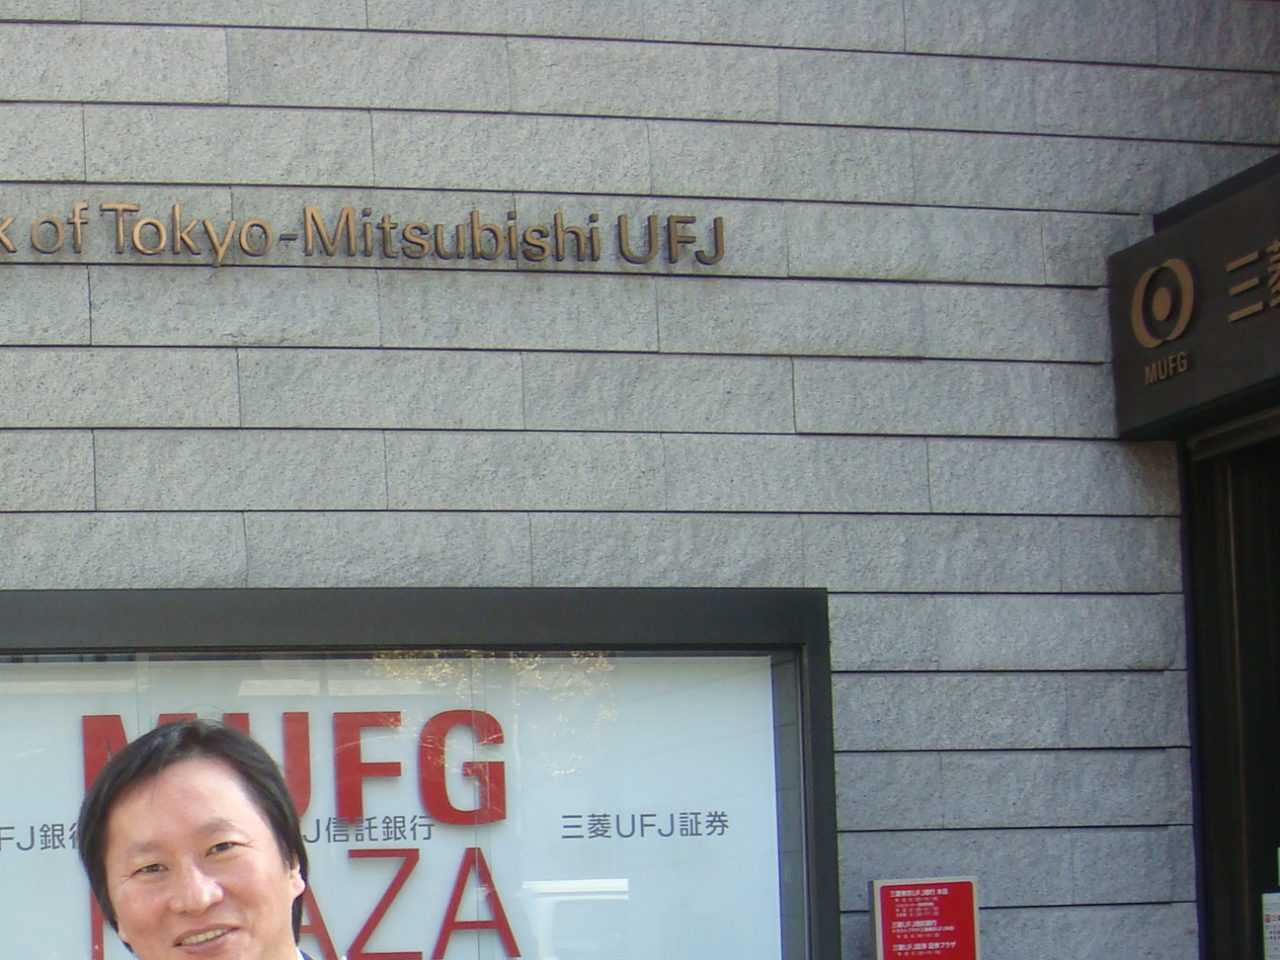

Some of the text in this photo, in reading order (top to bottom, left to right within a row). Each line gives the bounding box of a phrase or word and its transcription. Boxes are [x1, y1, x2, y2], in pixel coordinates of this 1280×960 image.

[30, 202, 89, 254] of
[619, 213, 725, 265] UFJ
[1145, 351, 1188, 384] MUFG
[561, 811, 729, 839] 三菱UFJ証券
